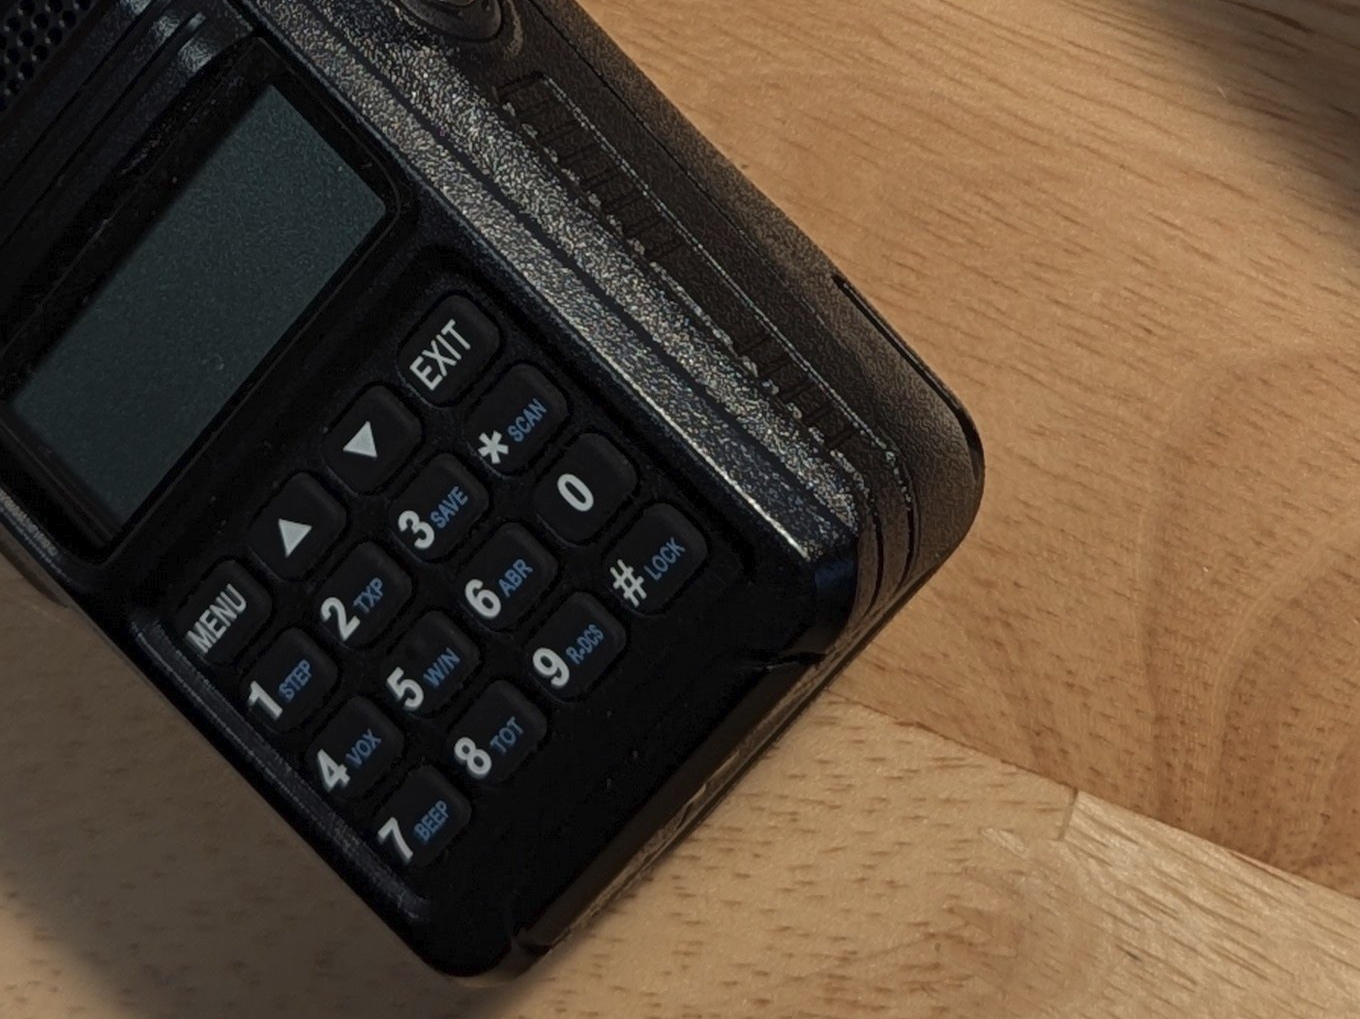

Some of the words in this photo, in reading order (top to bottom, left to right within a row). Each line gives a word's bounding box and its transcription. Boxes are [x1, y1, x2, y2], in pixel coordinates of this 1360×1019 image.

[410, 320, 471, 391] EXIT
[508, 398, 547, 443] SCAN
[397, 508, 435, 550] 3
[430, 486, 469, 531] SAVE
[557, 473, 594, 512] 0
[464, 579, 502, 619] 6
[497, 558, 534, 599] ABR
[610, 559, 648, 607] #
[643, 537, 686, 583] LOCK
[186, 585, 247, 656] MENU
[320, 596, 361, 641] 2
[353, 577, 384, 615] TXP
[247, 680, 284, 720] 1
[279, 659, 314, 702] STEP
[386, 668, 425, 711] 5
[531, 647, 571, 688] 9
[315, 749, 351, 792] 4
[346, 728, 383, 770] VOX
[453, 736, 492, 779] 8
[490, 715, 525, 756] TOT
[377, 817, 415, 865] 7
[413, 800, 449, 843] BEEP
